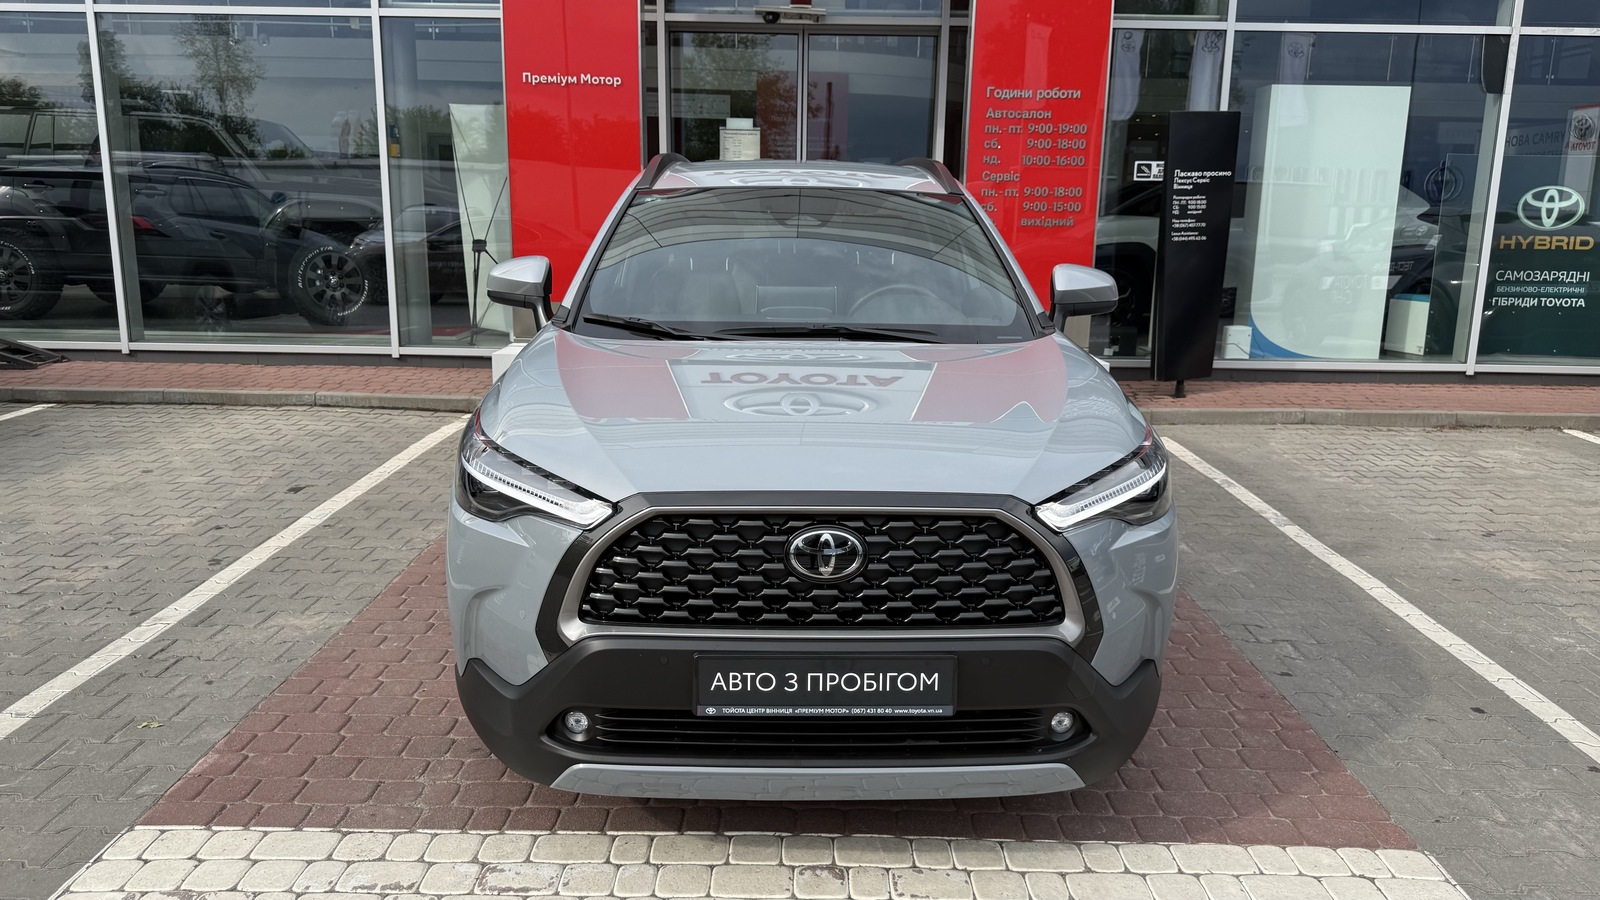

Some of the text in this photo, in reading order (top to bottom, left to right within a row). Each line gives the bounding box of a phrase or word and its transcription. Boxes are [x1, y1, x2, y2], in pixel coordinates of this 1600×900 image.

[522, 72, 622, 87] Преміум Мотор
[986, 86, 1081, 100] Години роботи
[985, 108, 1051, 119] Автосалон
[984, 138, 1001, 149] сб.
[983, 155, 1001, 165] нд.
[982, 170, 1020, 183] Сервіс
[1174, 169, 1202, 177] Ласкаво
[1021, 216, 1074, 227] вихідний
[1500, 235, 1595, 251] HYBRID
[1495, 270, 1590, 284] САМОЗАРЯДНІ
[1496, 286, 1585, 294] БЕНЗИНОВО-ЕЛЕКТРИЧНІ
[1492, 297, 1586, 308] ГІБРИДИ TOYOTA
[710, 672, 939, 692] АВТО З ПРОБІГОМ
